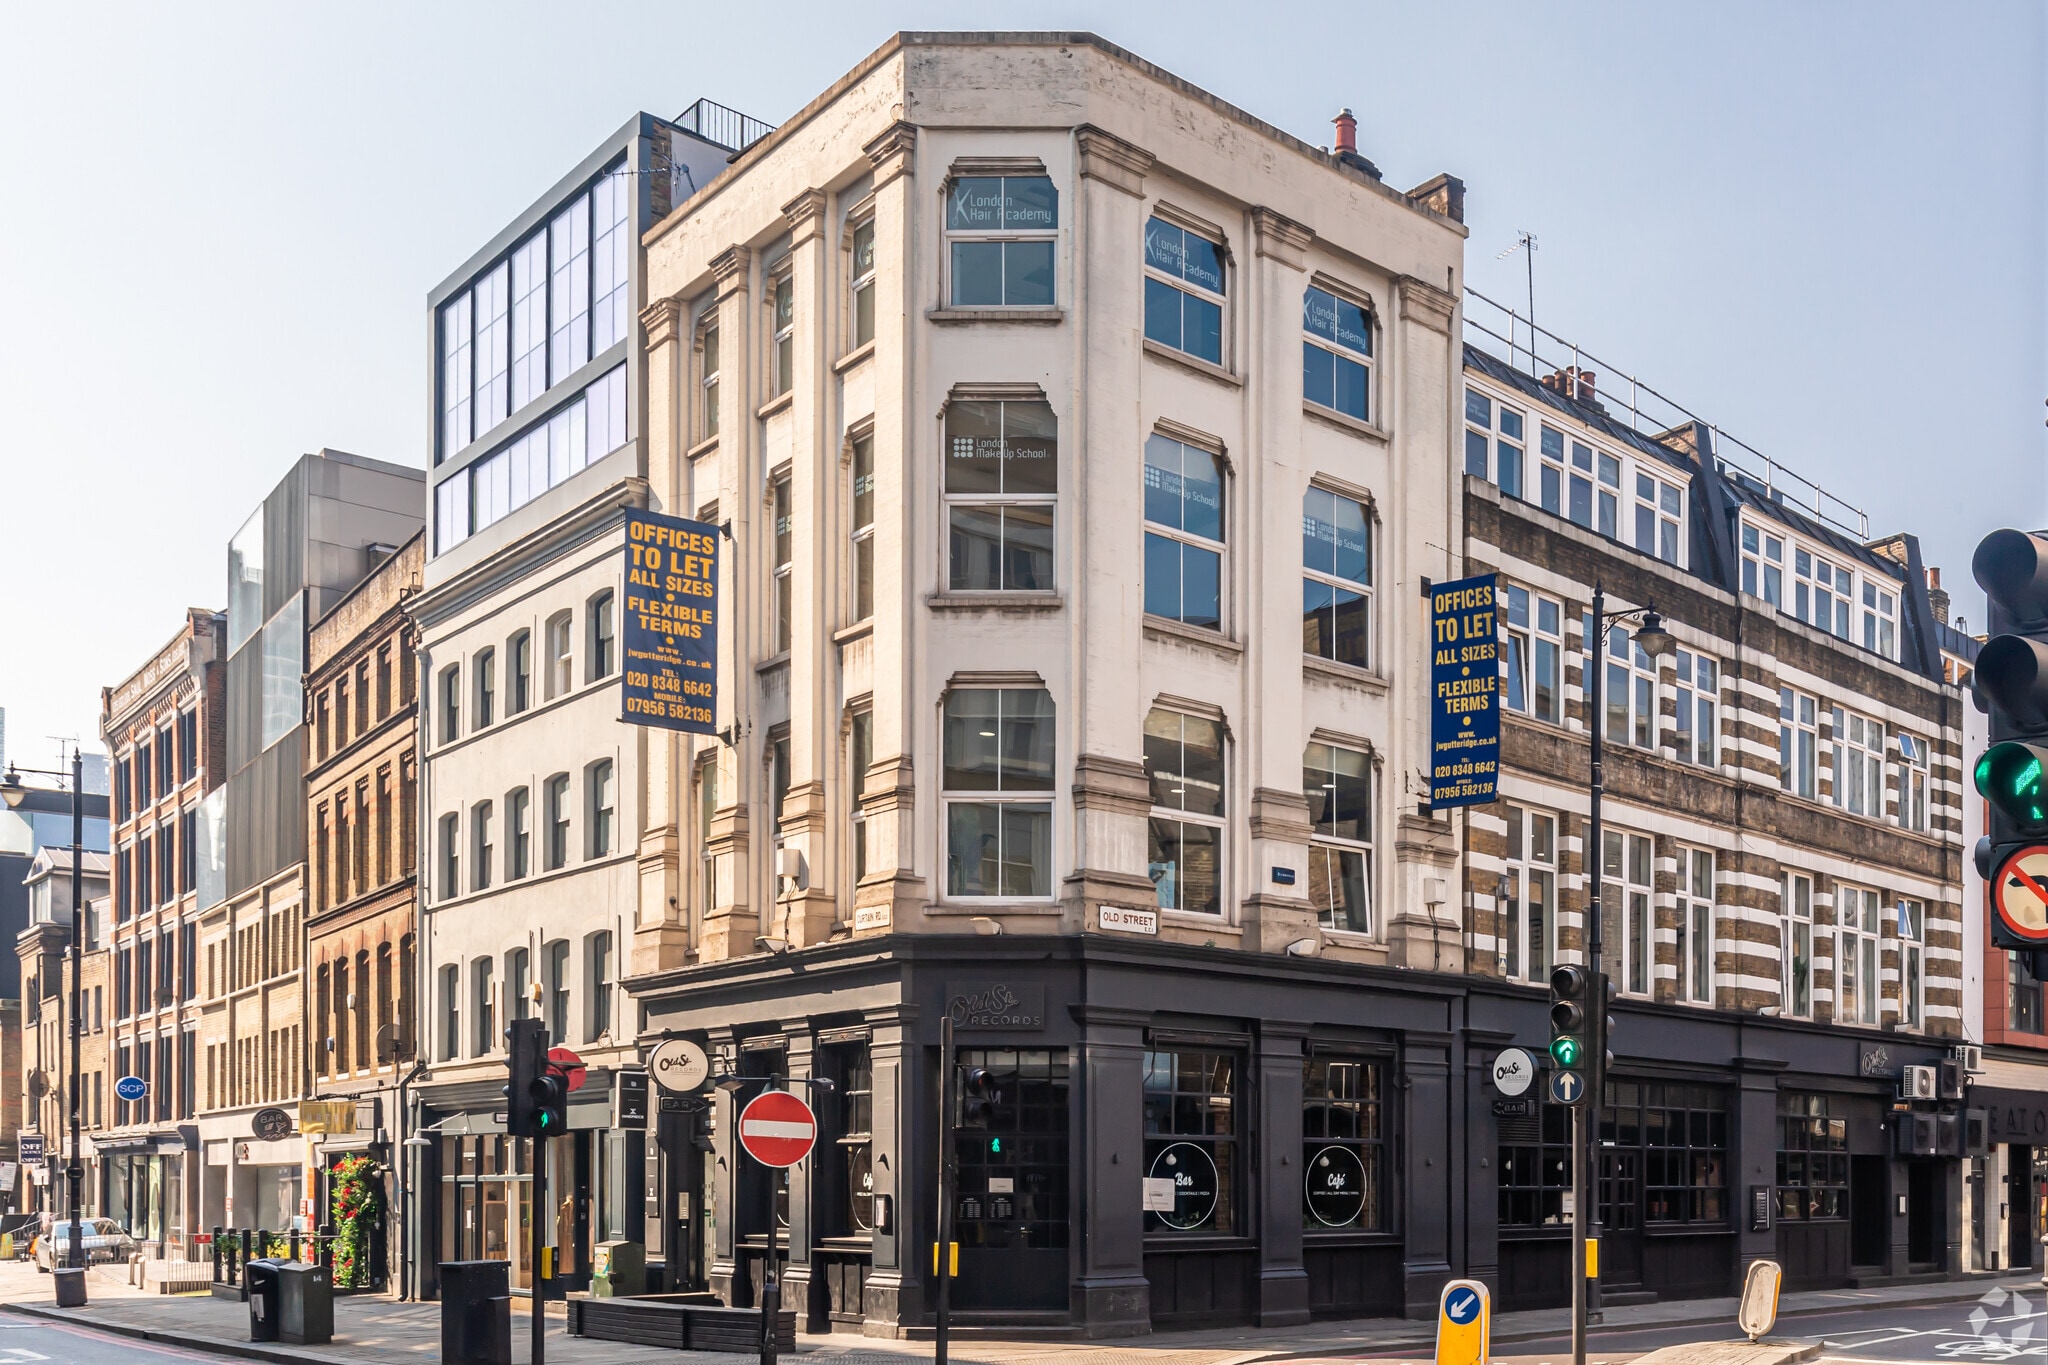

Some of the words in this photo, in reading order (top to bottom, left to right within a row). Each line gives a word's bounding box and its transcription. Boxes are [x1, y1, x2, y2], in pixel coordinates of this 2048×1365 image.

[970, 194, 1013, 207] London
[970, 208, 993, 220] Hair
[996, 207, 1052, 223] Academy
[1156, 234, 1189, 260] London
[1156, 247, 1173, 265] Hair
[1176, 257, 1218, 287] Academy
[1311, 301, 1341, 323] London
[1311, 314, 1327, 330] Hair
[976, 438, 1008, 448] London
[1016, 448, 1046, 458] School
[1192, 491, 1215, 506] School
[629, 521, 715, 555] OFFICES
[1343, 539, 1364, 553] School
[629, 543, 661, 570] TO
[670, 551, 714, 579] LET
[629, 568, 660, 589] ALL
[665, 575, 714, 598] SIZES
[1435, 585, 1492, 614] OFFICES
[628, 595, 713, 625] FLEXIBLE
[638, 614, 702, 639] TERMS
[1435, 617, 1458, 643] TO
[1463, 612, 1494, 639] LET
[656, 645, 683, 656] www.
[1435, 648, 1458, 666] ALL
[1461, 643, 1496, 662] SIZES
[661, 668, 679, 678] TEL:
[627, 671, 649, 688] 020
[651, 675, 680, 693] 8348
[683, 680, 712, 698] 6642
[1438, 676, 1495, 698] FLEXIBLE
[653, 692, 686, 704] MOBILE:
[1445, 694, 1489, 714] TERMS
[627, 697, 666, 717] 07956
[669, 703, 712, 723] 582136
[1457, 730, 1476, 739] www.
[1435, 736, 1497, 752] jwgutteridge.co.uk
[1435, 765, 1451, 778] 020
[1452, 763, 1473, 776] 8348
[1474, 760, 1496, 774] 6642
[1434, 786, 1460, 800] 07956
[1461, 782, 1494, 796] 582136
[1103, 911, 1120, 922] OLD
[1123, 913, 1154, 926] STREET
[945, 991, 990, 1027] Old
[971, 1015, 1041, 1026] RECORDS
[659, 1056, 679, 1071] Old
[1496, 1065, 1512, 1080] Old
[119, 1084, 144, 1093] SCP
[663, 1100, 689, 1109] BAR
[1504, 1104, 1524, 1112] BAR
[260, 1114, 283, 1124] BAR
[2007, 1106, 2027, 1131] AT
[1175, 1172, 1193, 1186] Bar
[1327, 1173, 1346, 1190] Café
